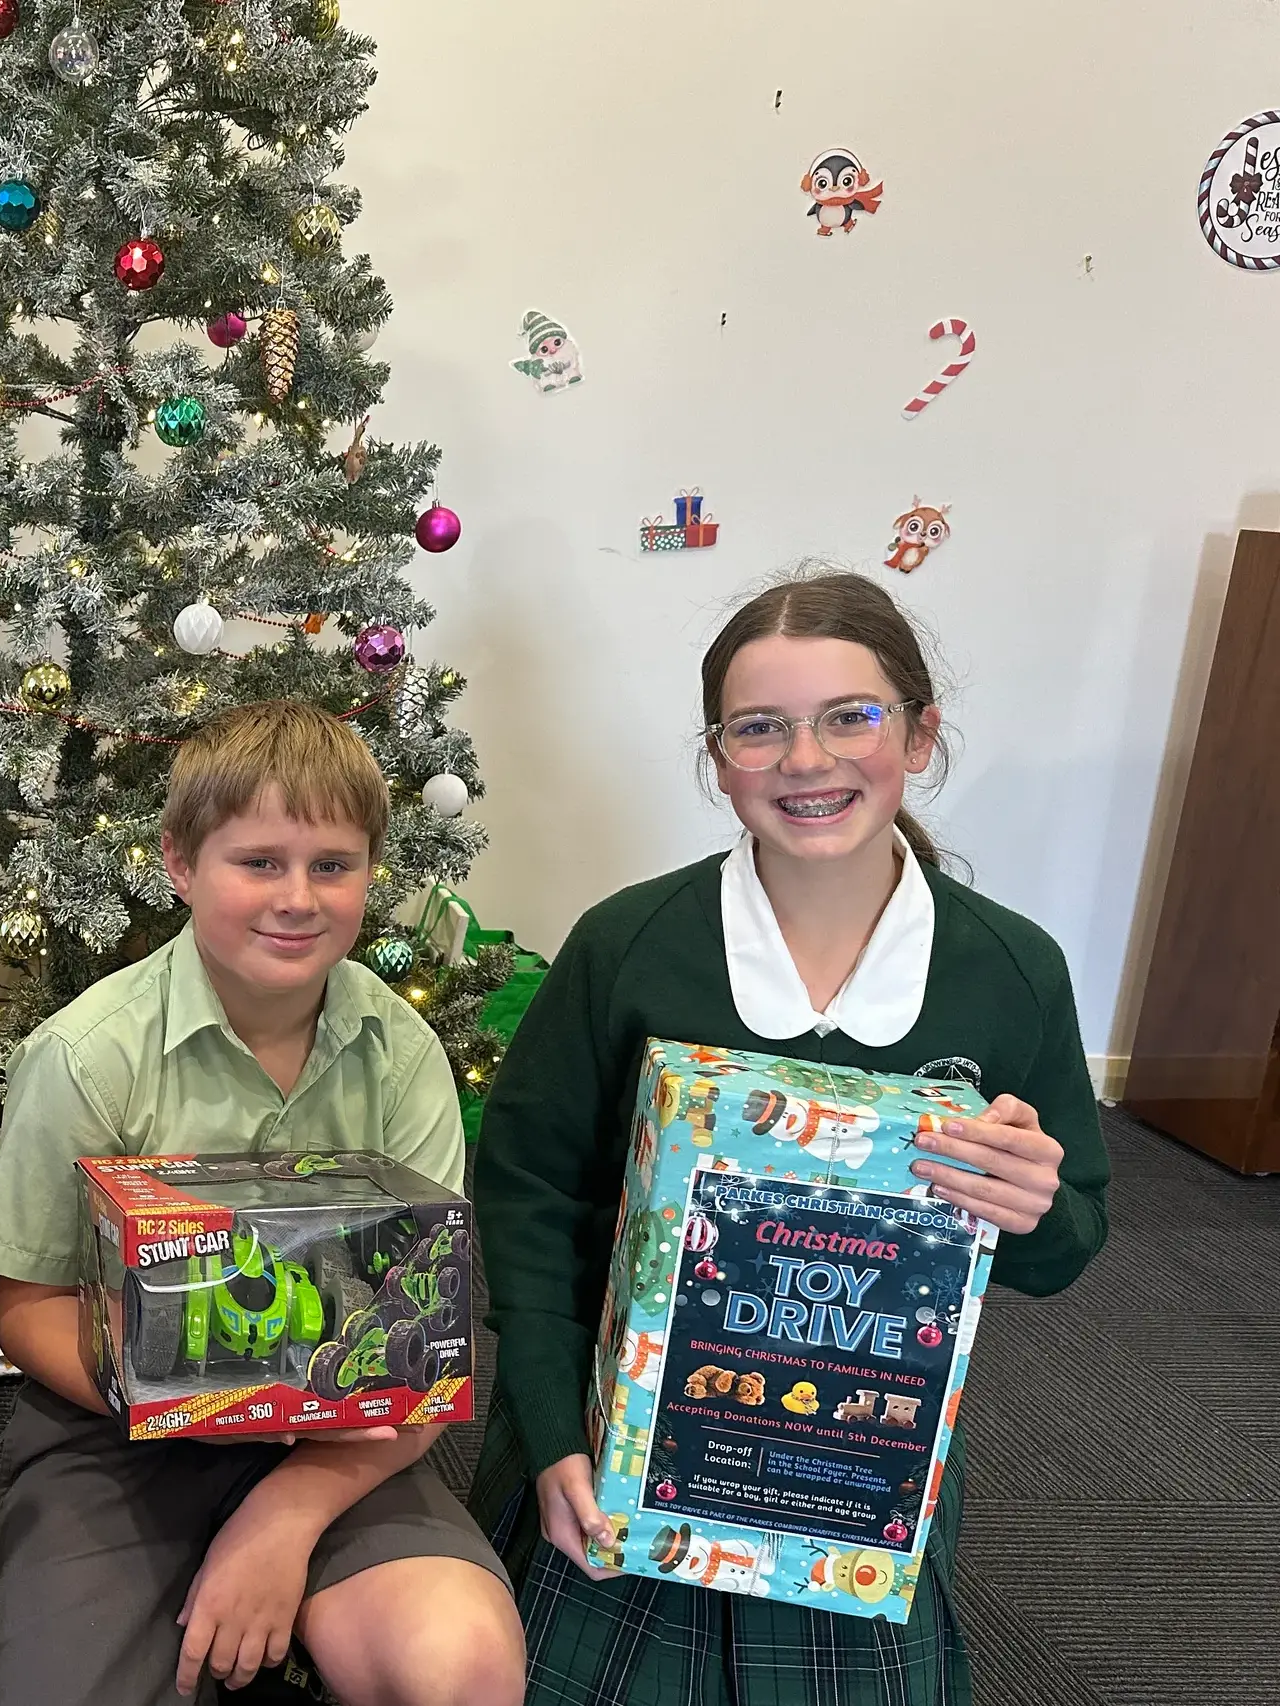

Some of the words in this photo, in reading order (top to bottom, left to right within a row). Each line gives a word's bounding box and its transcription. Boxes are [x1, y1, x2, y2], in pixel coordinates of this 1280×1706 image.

[97, 1163, 156, 1173] STUNT
[161, 1160, 202, 1169] CAR
[447, 1210, 463, 1220] 5+
[716, 1185, 783, 1205] PARKES
[786, 1195, 884, 1219] CHRISTIAN
[884, 1208, 958, 1231] SCHOOL
[137, 1220, 156, 1235] RC
[157, 1220, 167, 1234] 2
[168, 1219, 204, 1234] Sides
[137, 1236, 190, 1267] STUNT
[194, 1230, 230, 1254] CAR
[755, 1219, 901, 1261] Christmas
[769, 1254, 882, 1308] TOY
[723, 1289, 908, 1360] DRIVE
[429, 1337, 468, 1350] POWERFUL
[439, 1348, 460, 1359] DRIVE
[690, 1339, 741, 1359] BRINGING
[745, 1348, 807, 1368] CHRISTMAS
[810, 1359, 825, 1370] TO
[827, 1362, 878, 1379] FAMILIES
[880, 1371, 892, 1381] IN
[895, 1373, 926, 1387] NEED
[358, 1397, 393, 1410] UNIVERSAL
[424, 1403, 455, 1415] FUNCTION
[430, 1395, 445, 1405] FULL
[216, 1413, 245, 1426] ROTATES
[288, 1409, 338, 1424] RECHARGEABLE
[363, 1406, 390, 1418] WHEELS
[667, 1401, 720, 1420] Accepting
[724, 1410, 780, 1428] Donations
[784, 1421, 813, 1433] NOW
[816, 1425, 844, 1439] until
[847, 1431, 866, 1443] 5th
[870, 1435, 927, 1453] December
[708, 1440, 753, 1457] Drop-off
[704, 1453, 752, 1469] Location:
[769, 1451, 799, 1463] Under
[800, 1455, 810, 1464] the
[811, 1457, 852, 1472] Christmas
[854, 1465, 873, 1475] Tree
[766, 1466, 780, 1474] can
[782, 1467, 793, 1476] be
[795, 1471, 831, 1484] wrapped
[844, 1479, 891, 1493] unwrapped
[768, 1458, 774, 1466] in
[775, 1460, 787, 1469] the
[794, 1462, 821, 1474] School
[822, 1467, 848, 1480] Foyer.
[851, 1471, 886, 1485] Presents
[687, 1482, 720, 1494] suitable
[721, 1487, 734, 1497] for
[743, 1490, 761, 1502] boy,
[763, 1494, 778, 1505] girl
[791, 1499, 816, 1511] either
[817, 1502, 833, 1512] and
[835, 1506, 850, 1517] age
[851, 1509, 877, 1521] group
[693, 1474, 701, 1483] If
[702, 1476, 717, 1486] you
[719, 1479, 740, 1490] wrap
[742, 1483, 761, 1493] your
[763, 1486, 780, 1497] gift,
[782, 1489, 809, 1501] please
[810, 1492, 844, 1507] indicate
[845, 1499, 853, 1509] if
[854, 1501, 862, 1509] it
[863, 1502, 871, 1511] is
[654, 1500, 669, 1509] THIS
[682, 1505, 701, 1514] DRIVE
[709, 1510, 726, 1519] PART
[736, 1515, 748, 1523] THE
[749, 1517, 773, 1527] PARKES
[774, 1521, 808, 1532] COMBINED
[808, 1527, 841, 1538] CHARITIES
[841, 1532, 878, 1544] CHRISTMAS
[878, 1539, 903, 1549] APPEAL
